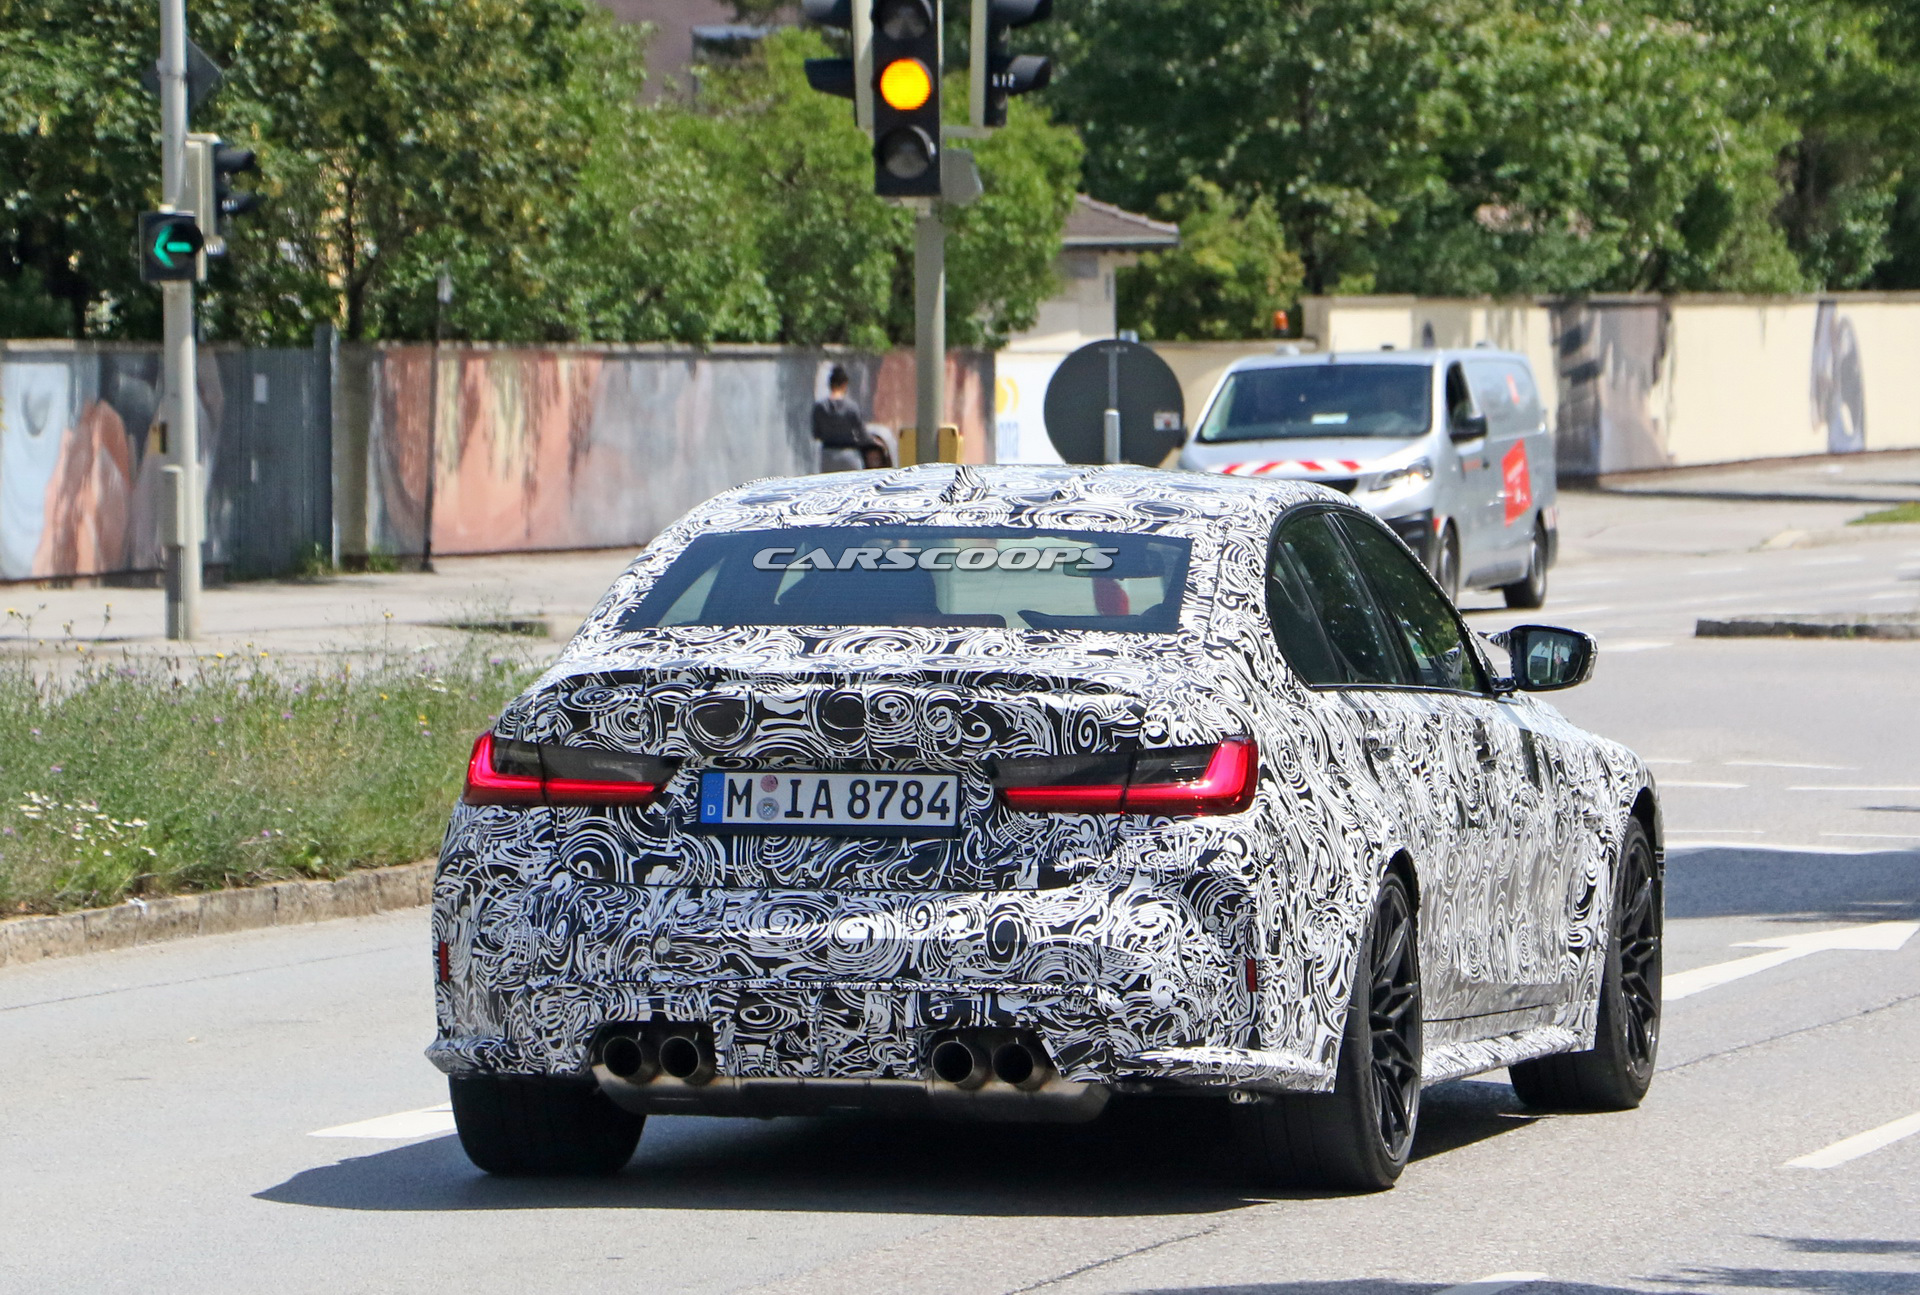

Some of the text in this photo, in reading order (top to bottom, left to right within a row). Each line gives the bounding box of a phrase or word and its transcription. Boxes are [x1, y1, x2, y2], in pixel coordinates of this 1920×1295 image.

[706, 804, 716, 816] D
[726, 778, 950, 820] M IA 8784
